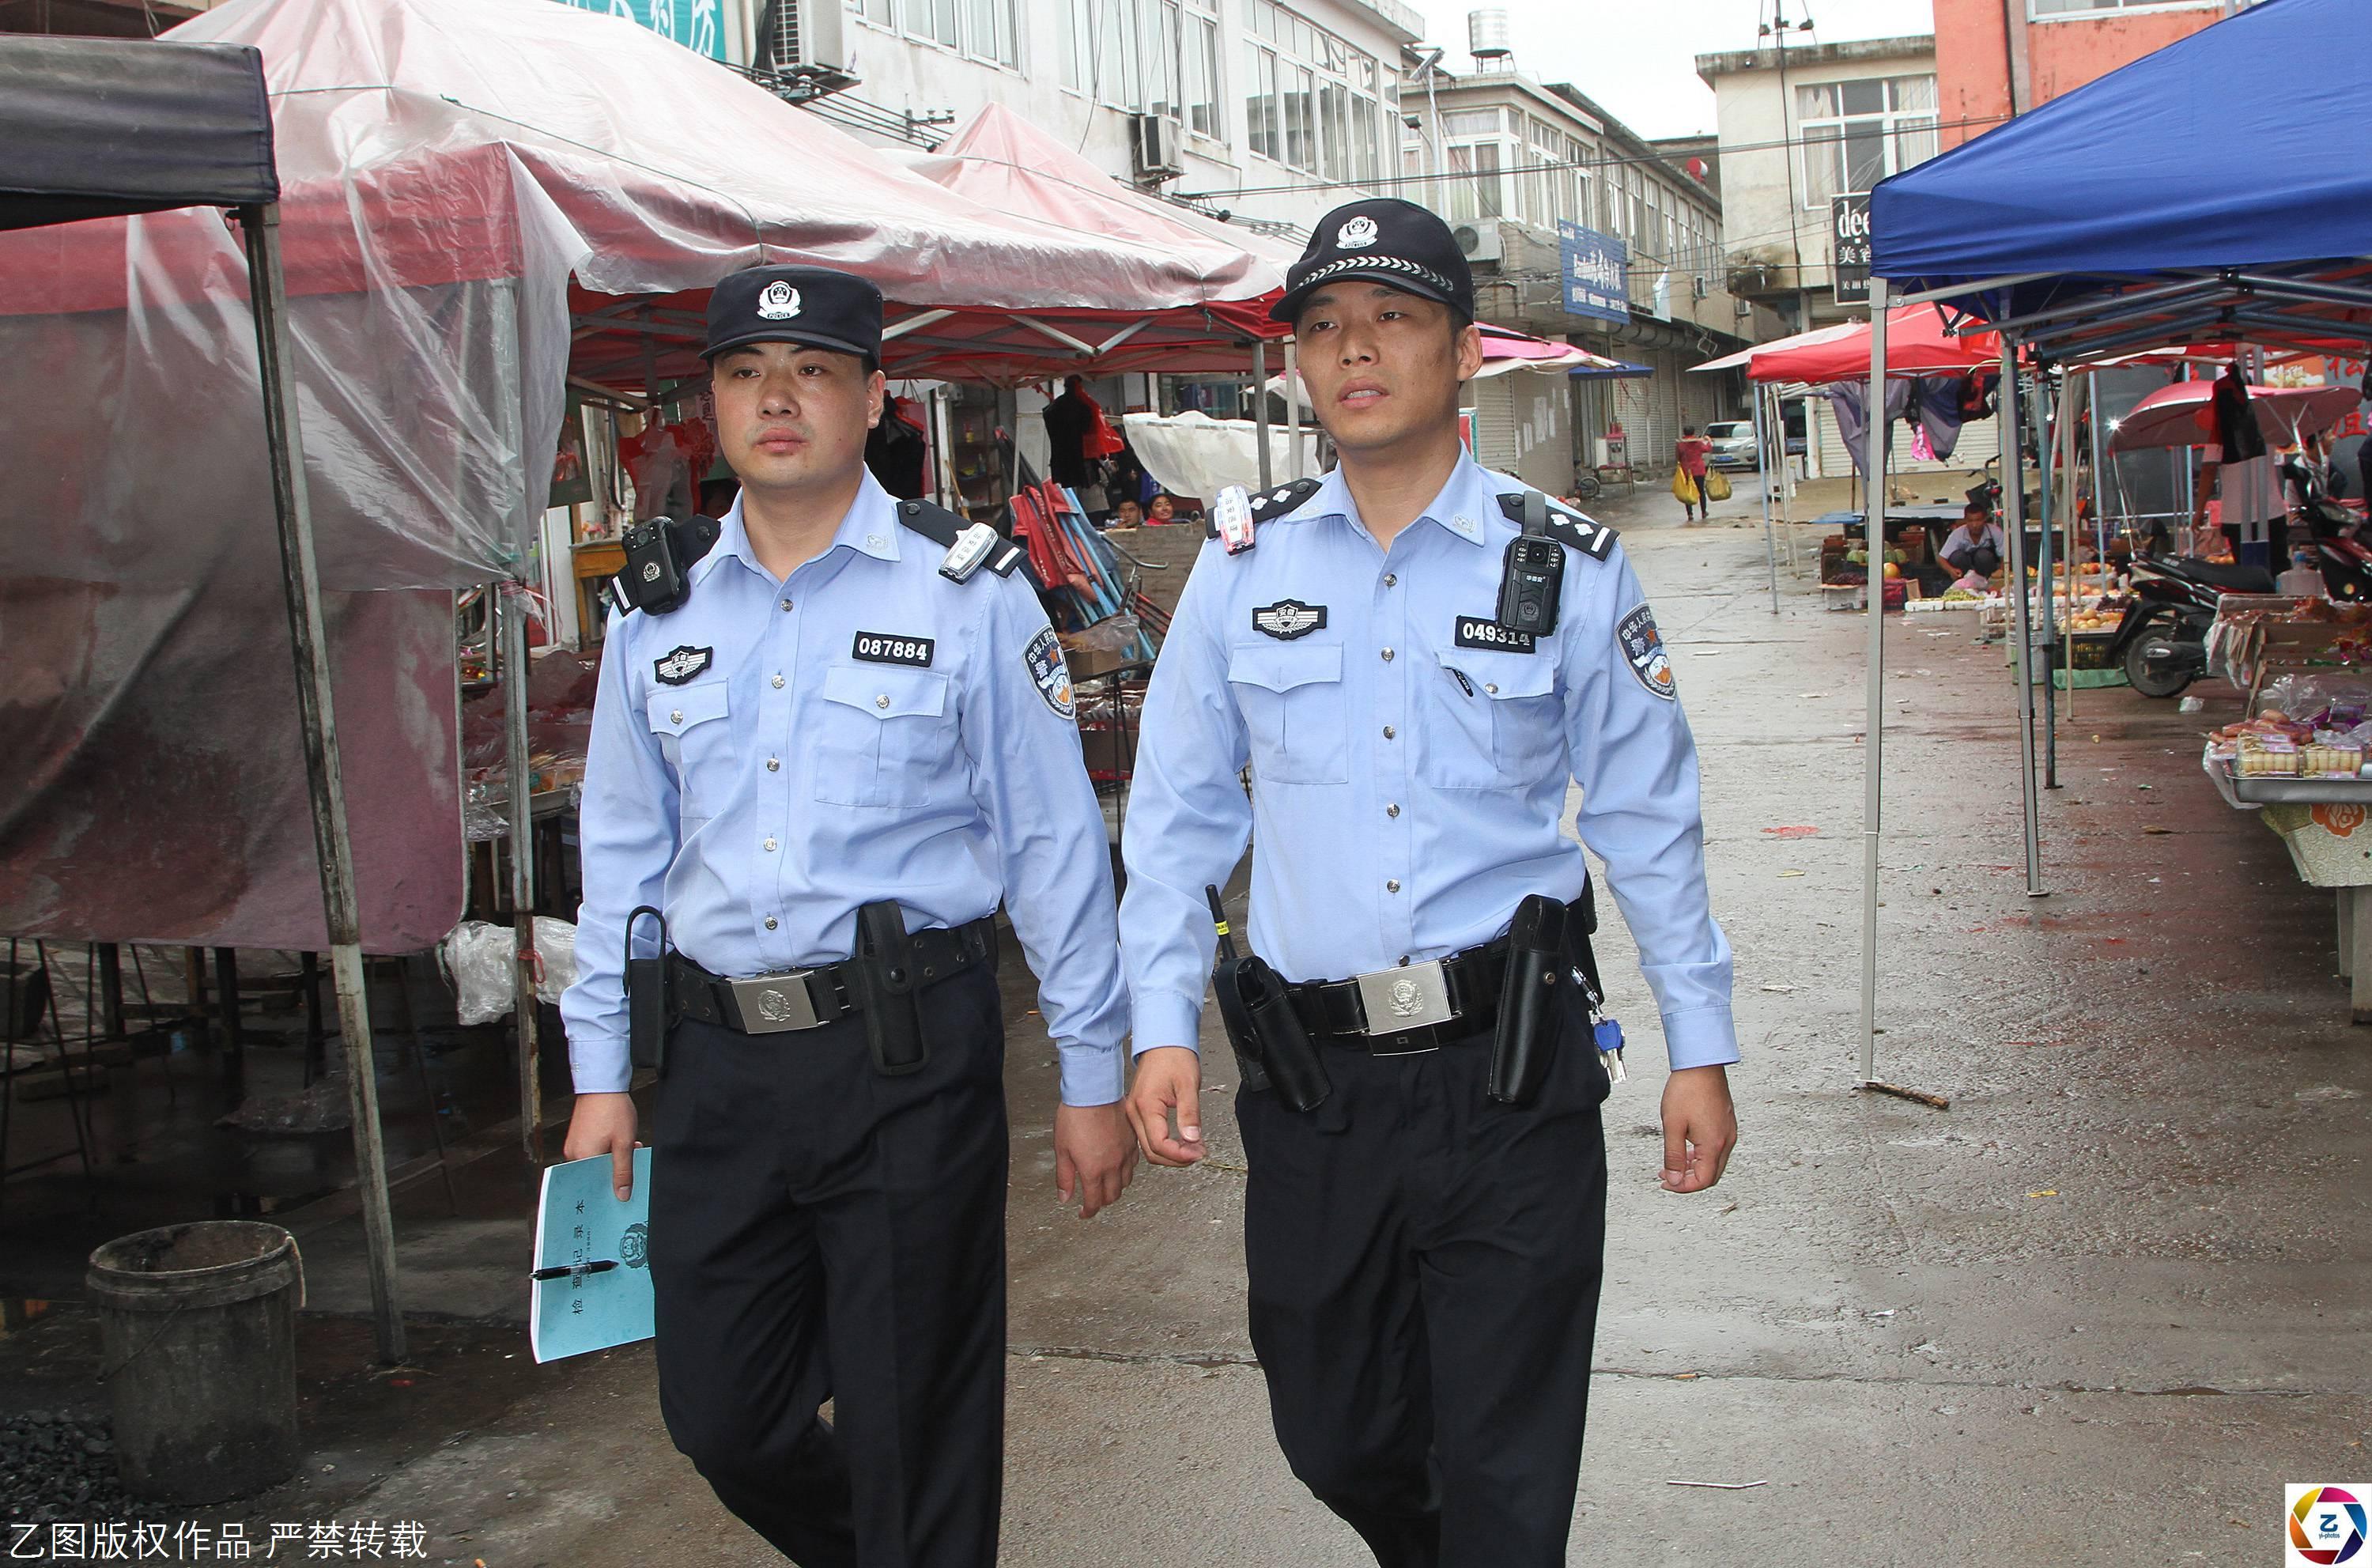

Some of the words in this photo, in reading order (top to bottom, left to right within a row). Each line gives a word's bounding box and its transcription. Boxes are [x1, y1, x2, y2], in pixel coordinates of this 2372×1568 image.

[1463, 622, 1531, 646] 049314
[859, 637, 927, 660] 087884
[572, 1200, 585, 1315] 检查记录本
